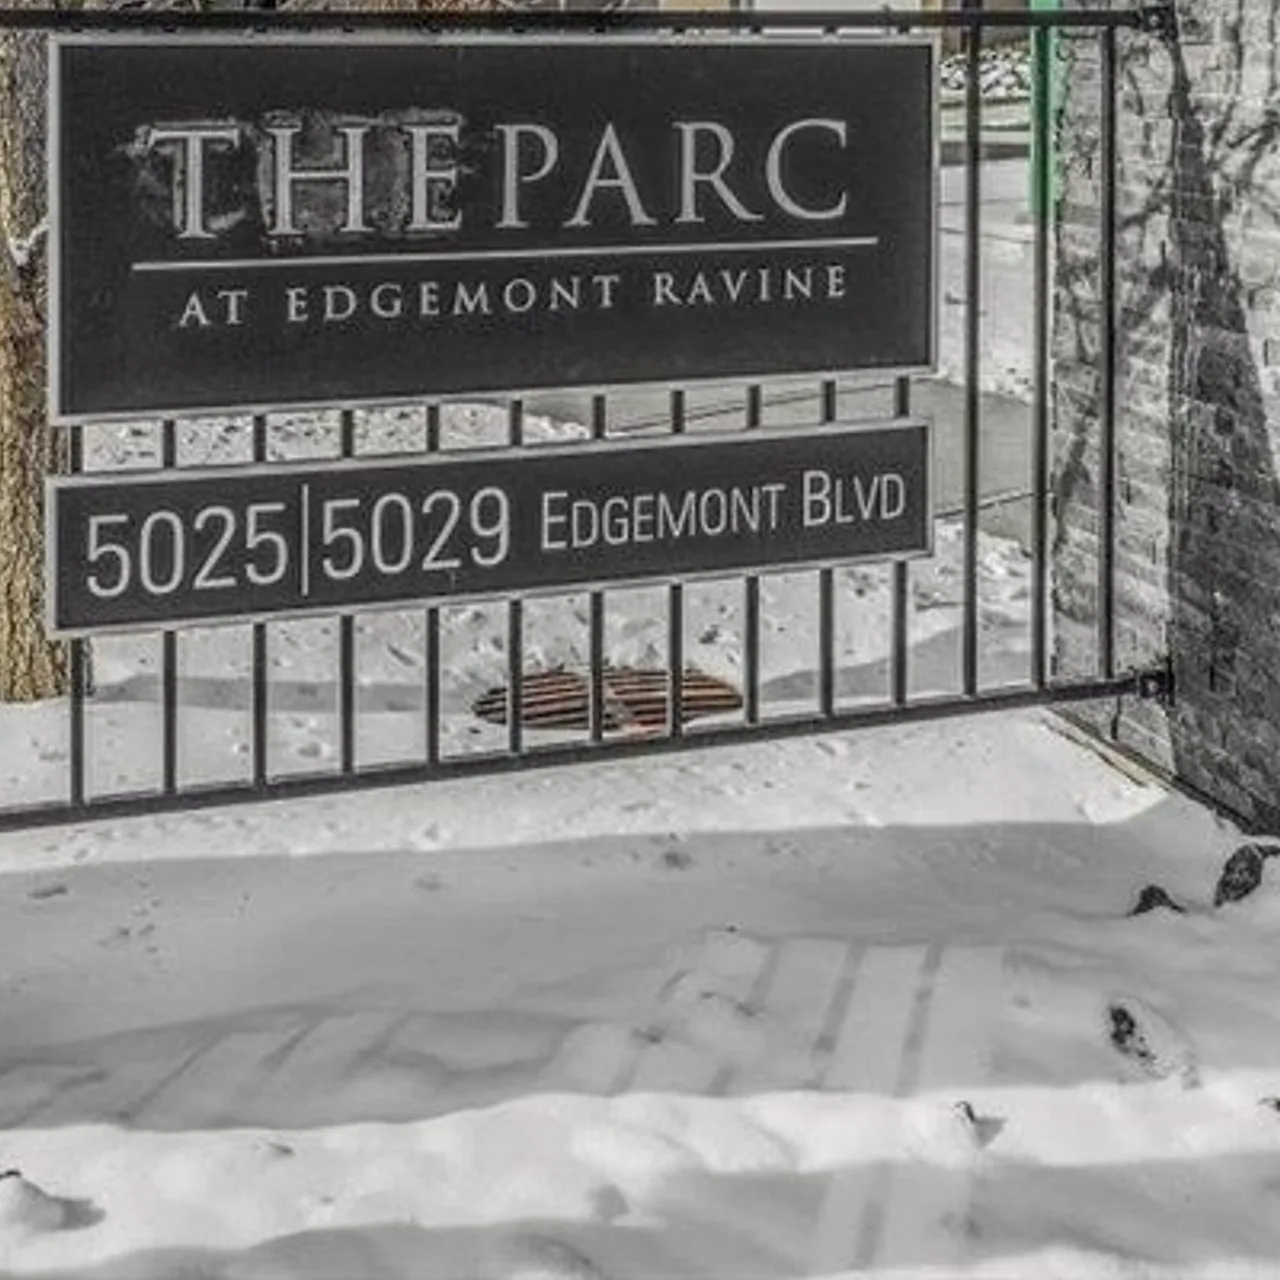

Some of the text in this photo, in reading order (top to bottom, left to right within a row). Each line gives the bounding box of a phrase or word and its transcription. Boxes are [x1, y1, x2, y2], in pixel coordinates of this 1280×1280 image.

[179, 264, 848, 327] AT EDGEMONT RAVINE
